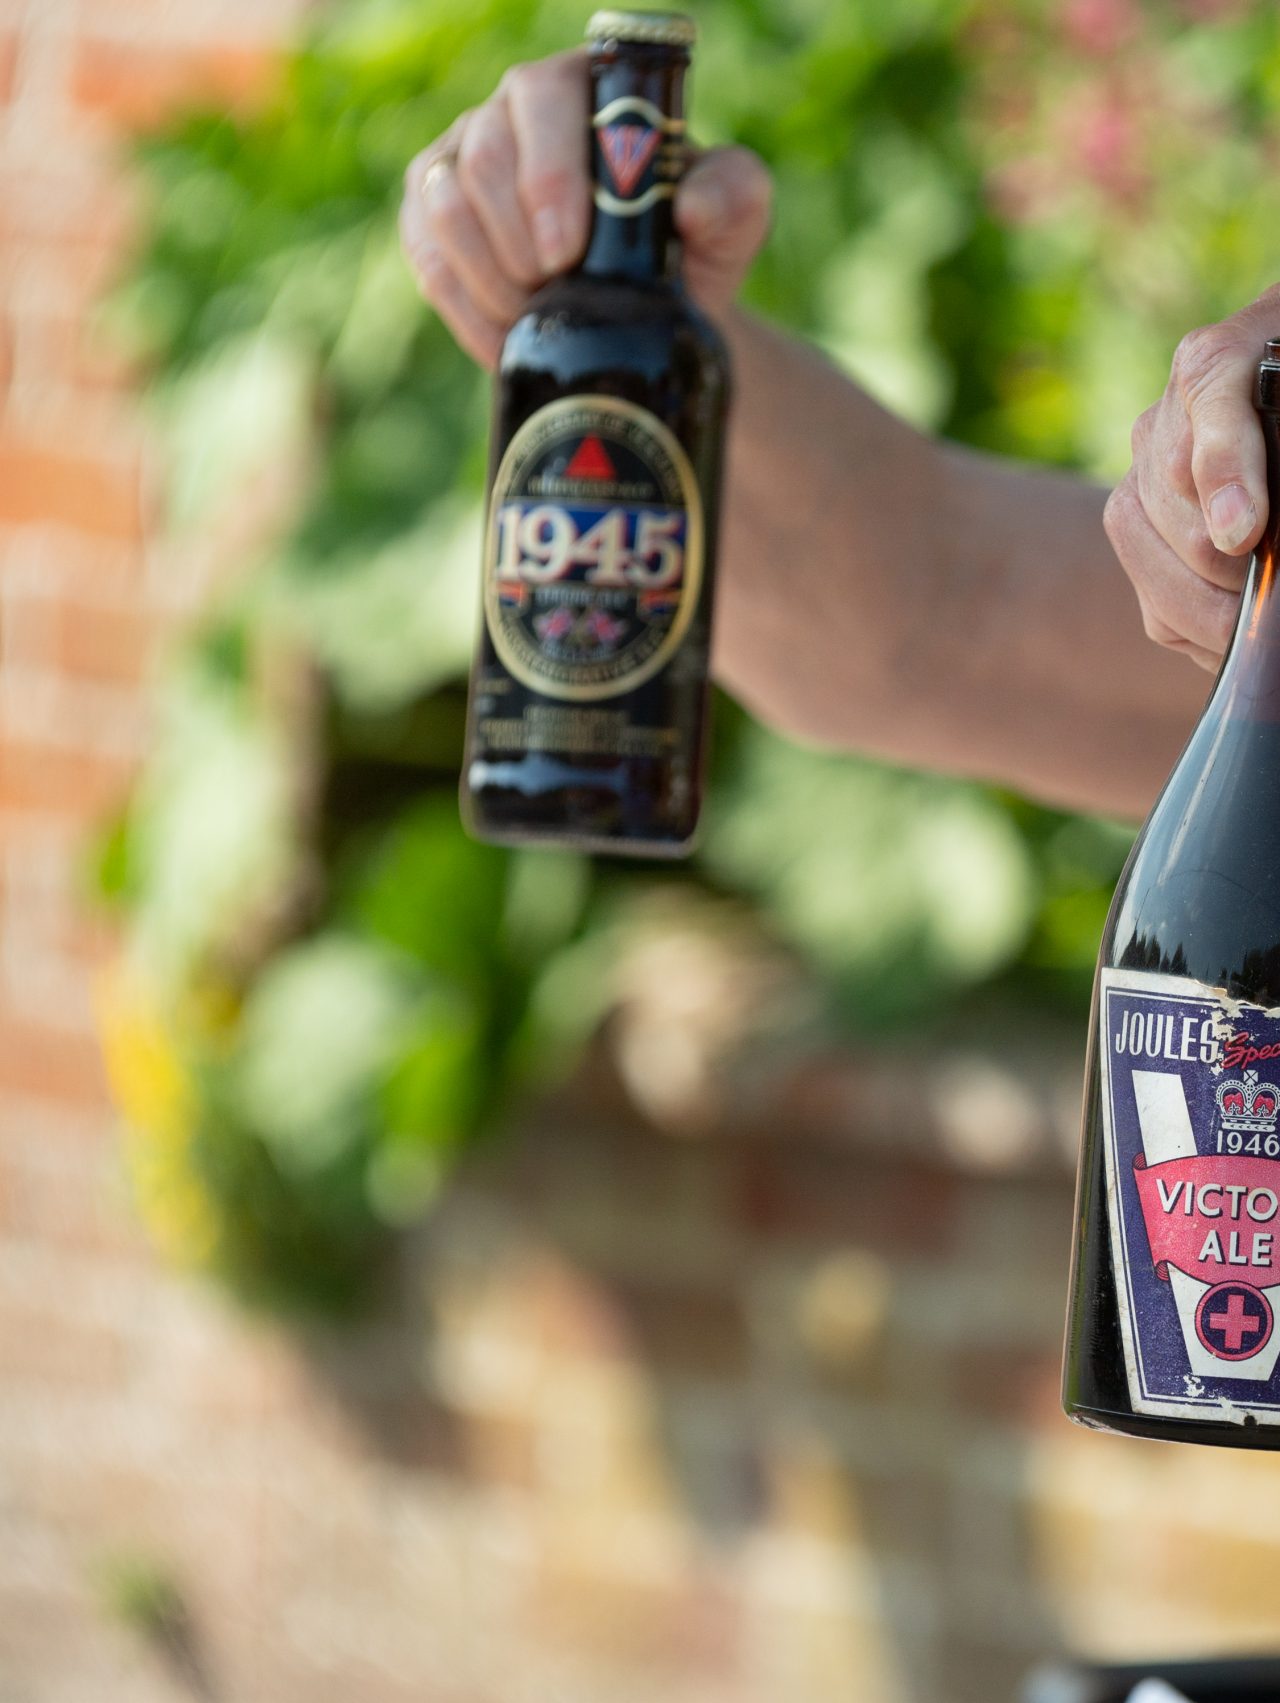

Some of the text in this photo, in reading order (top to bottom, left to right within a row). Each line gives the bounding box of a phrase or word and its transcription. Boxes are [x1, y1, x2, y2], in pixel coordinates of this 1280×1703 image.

[494, 503, 684, 590] 1945
[1115, 1010, 1220, 1064] JOULES
[1216, 1130, 1280, 1157] 1946
[1198, 1229, 1273, 1268] ALE
